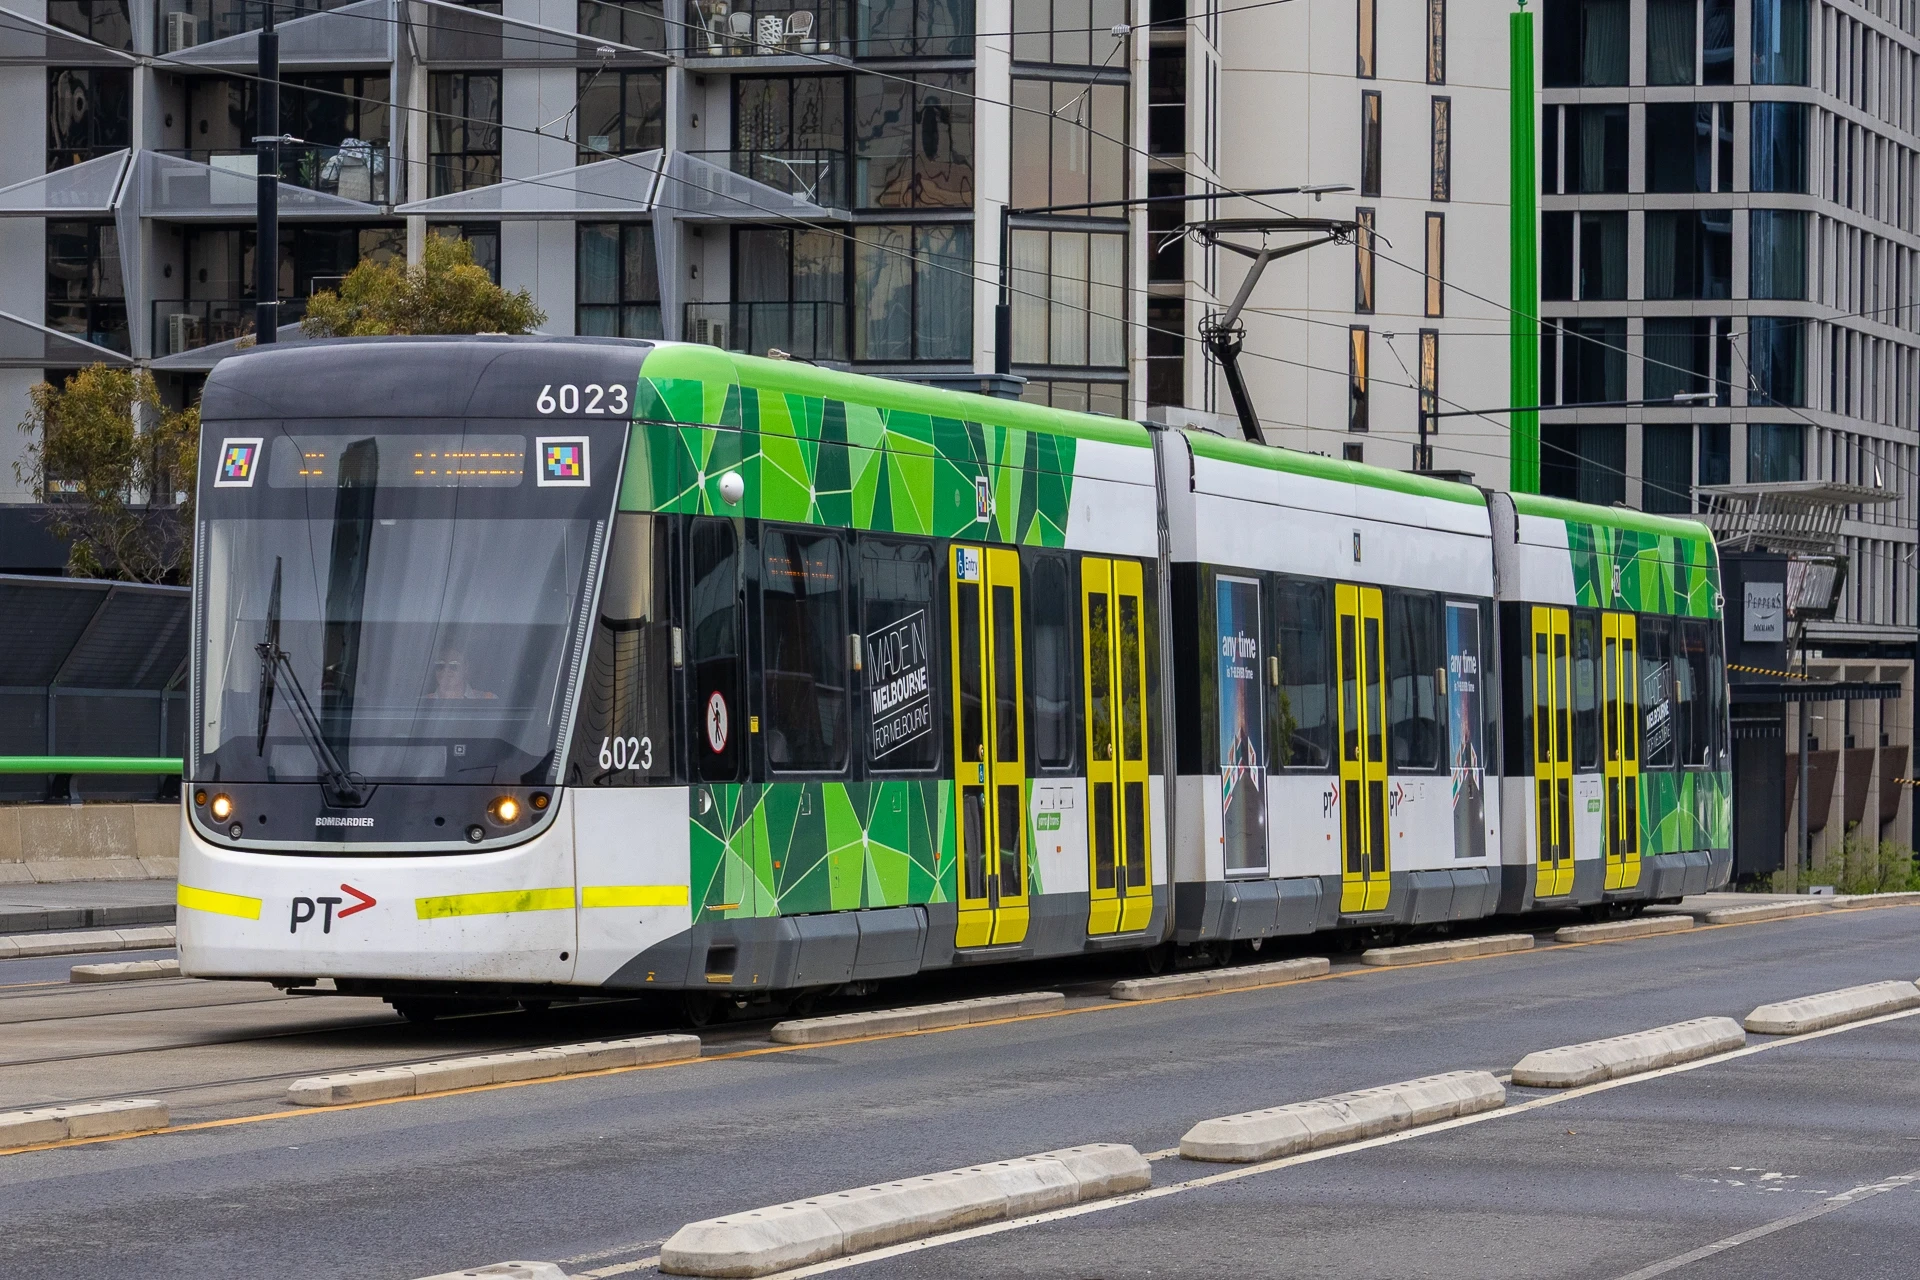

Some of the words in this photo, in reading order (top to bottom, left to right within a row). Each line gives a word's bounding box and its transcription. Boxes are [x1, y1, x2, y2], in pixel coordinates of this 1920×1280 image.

[536, 384, 628, 415] 6023
[965, 556, 978, 576] Entry
[869, 625, 911, 686] MADE
[911, 618, 926, 665] IN
[1222, 635, 1237, 663] any
[1238, 630, 1256, 659] time
[1450, 654, 1462, 679] any
[1462, 649, 1477, 675] time
[872, 666, 927, 715] MELBOURNE
[875, 724, 890, 750] FOR
[889, 703, 929, 742] MELBOURNE
[599, 736, 653, 770] 6023
[315, 816, 375, 827] BOMBARDIER
[290, 896, 343, 934] PT
